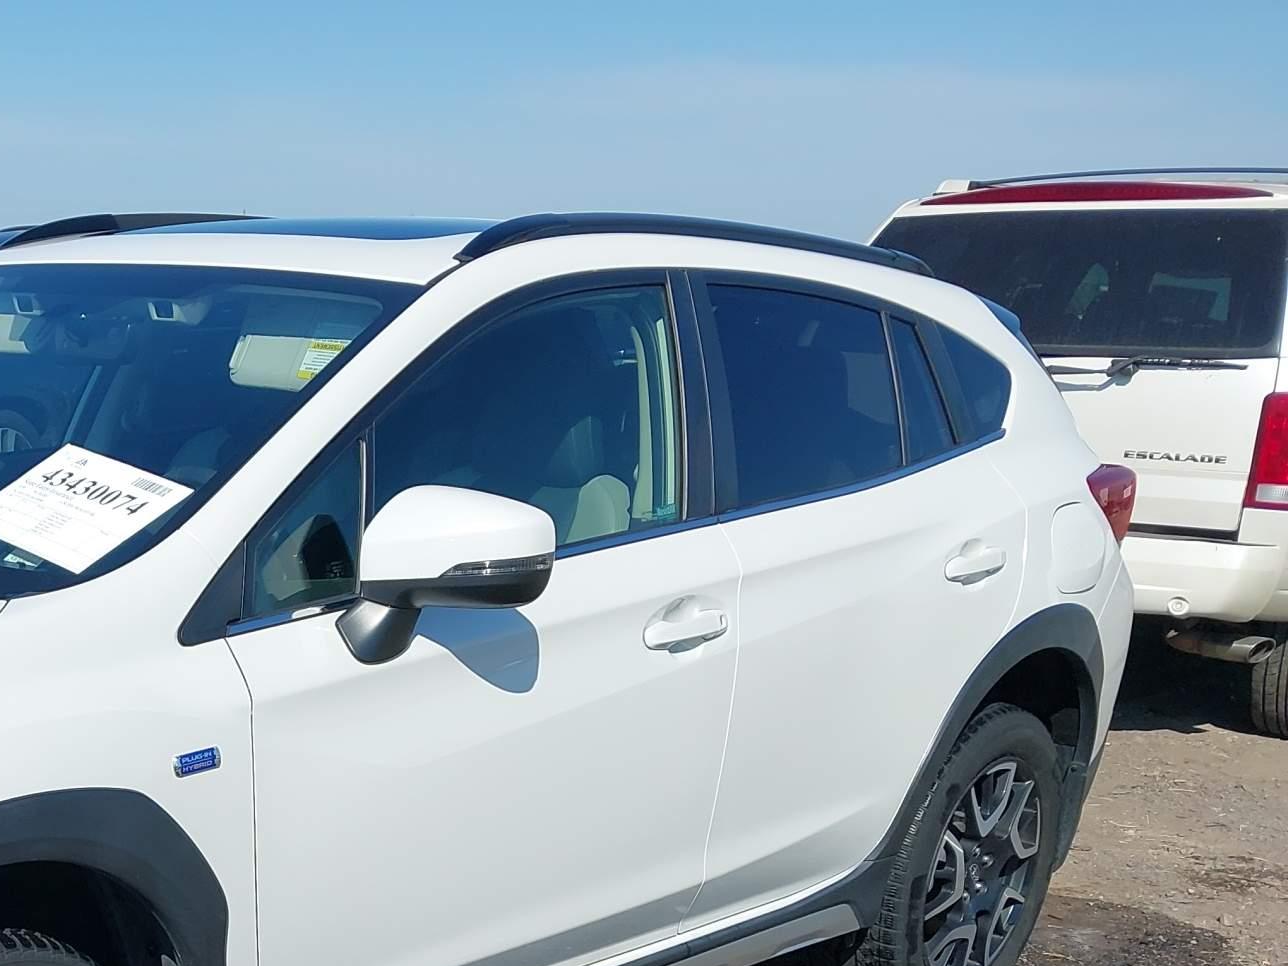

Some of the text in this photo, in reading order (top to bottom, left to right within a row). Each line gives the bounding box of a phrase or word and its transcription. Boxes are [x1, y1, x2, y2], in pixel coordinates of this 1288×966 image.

[1123, 450, 1228, 465] ESCALADE
[41, 468, 150, 516] 43430074
[181, 750, 212, 764] PLUG-IN
[182, 760, 213, 773] HYBRID
